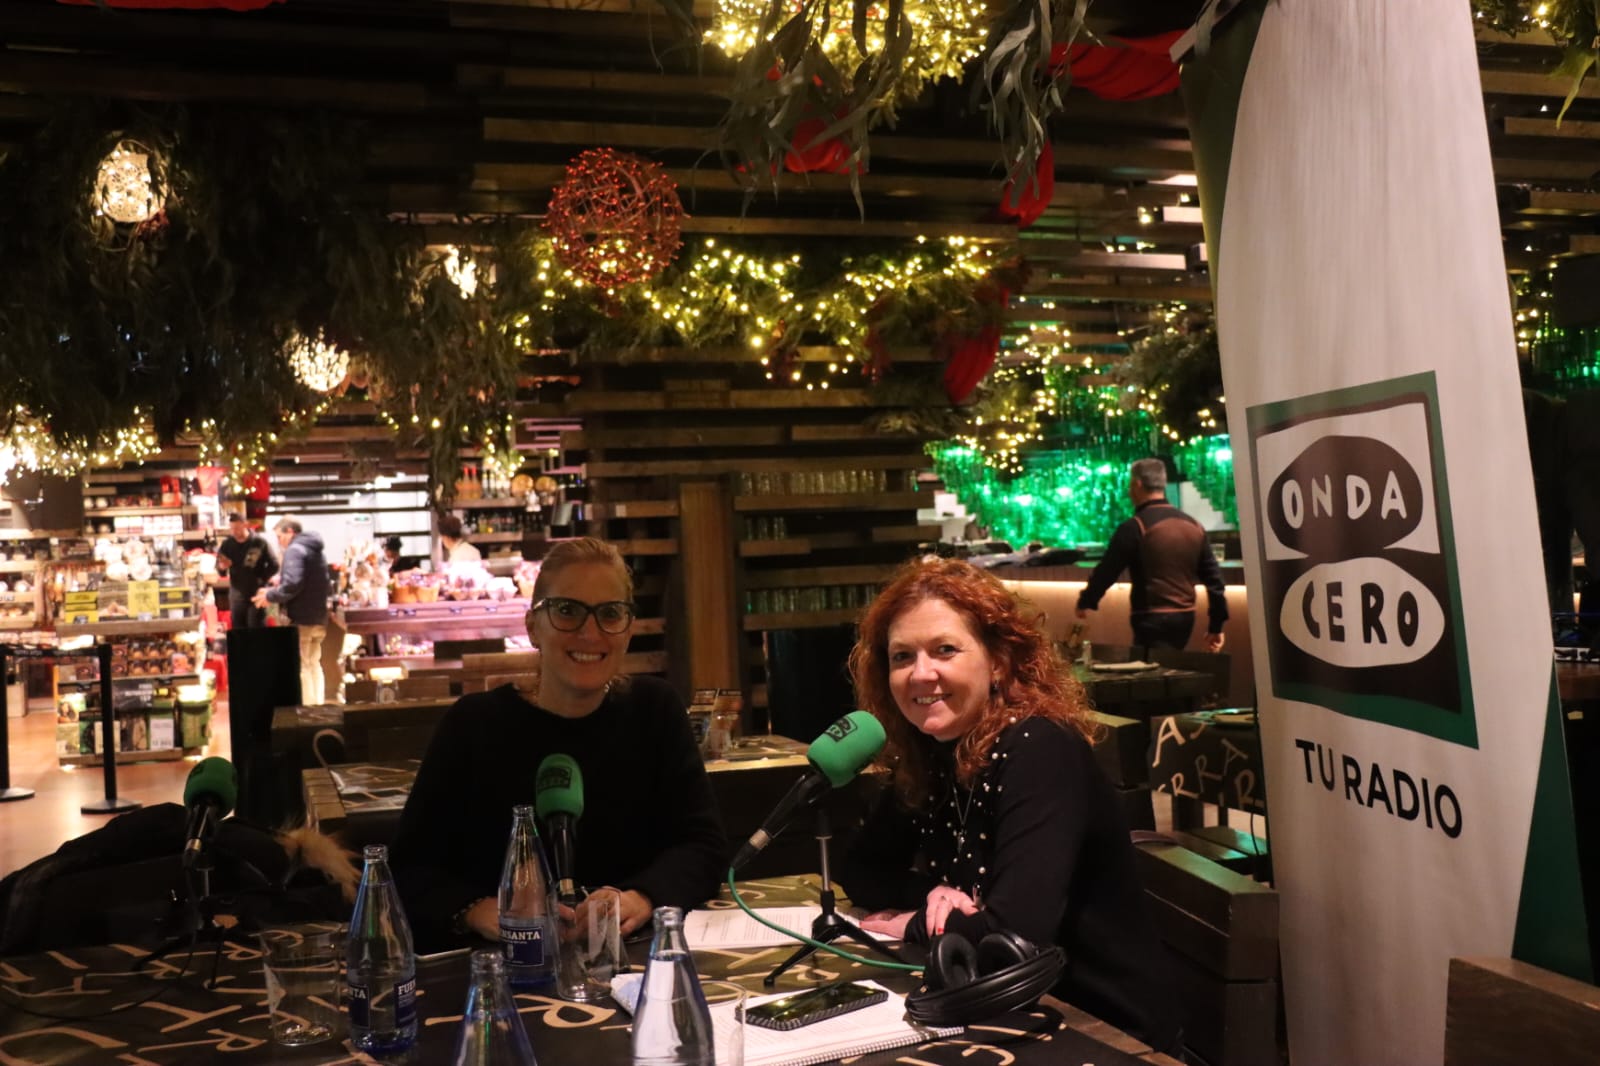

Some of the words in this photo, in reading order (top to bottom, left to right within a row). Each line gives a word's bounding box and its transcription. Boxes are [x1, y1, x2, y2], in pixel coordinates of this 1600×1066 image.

[1281, 470, 1407, 529] ONDA
[1302, 580, 1419, 647] CERO
[1295, 739, 1335, 792] TU
[1342, 754, 1462, 839] RADIO
